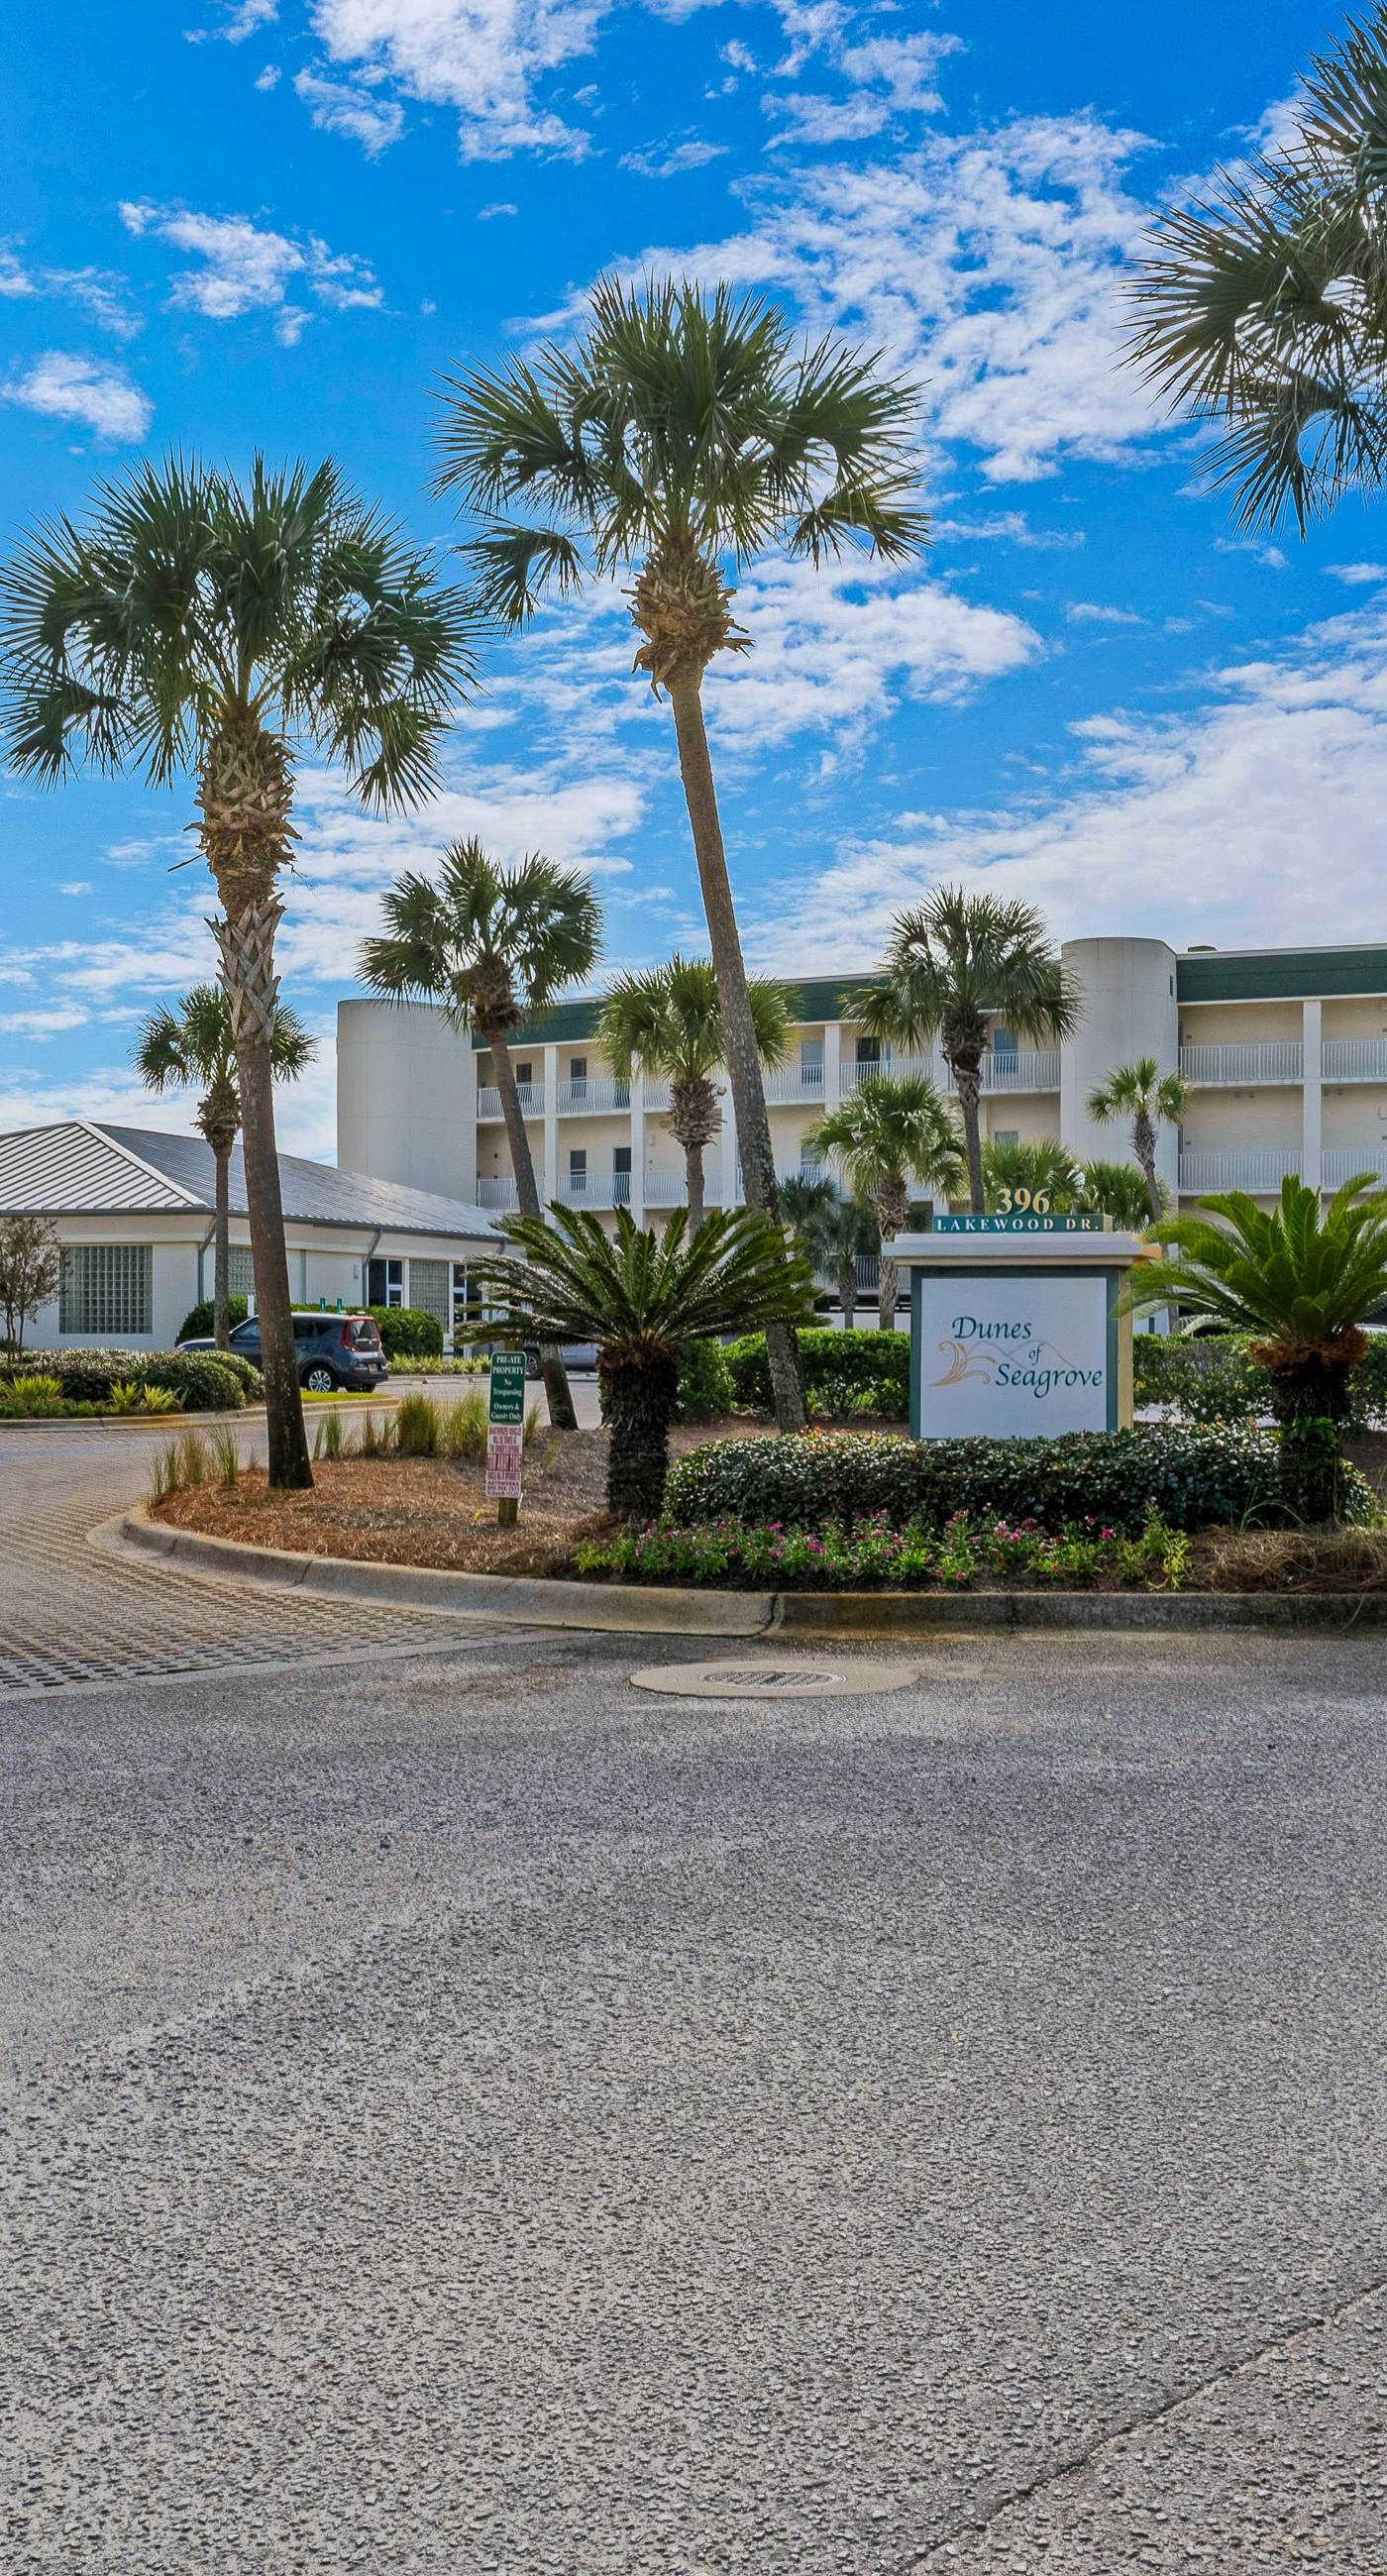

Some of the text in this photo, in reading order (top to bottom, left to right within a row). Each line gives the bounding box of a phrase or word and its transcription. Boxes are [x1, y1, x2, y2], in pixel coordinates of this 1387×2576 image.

[996, 1188, 1051, 1215] 396
[937, 1218, 1100, 1231] LAKEWOOD DR.
[951, 1316, 1032, 1340] Dunes
[1027, 1342, 1045, 1364] of
[492, 1366, 524, 1375] PROPERTY
[995, 1363, 1103, 1398] Seagrove
[508, 1412, 522, 1422] Only
